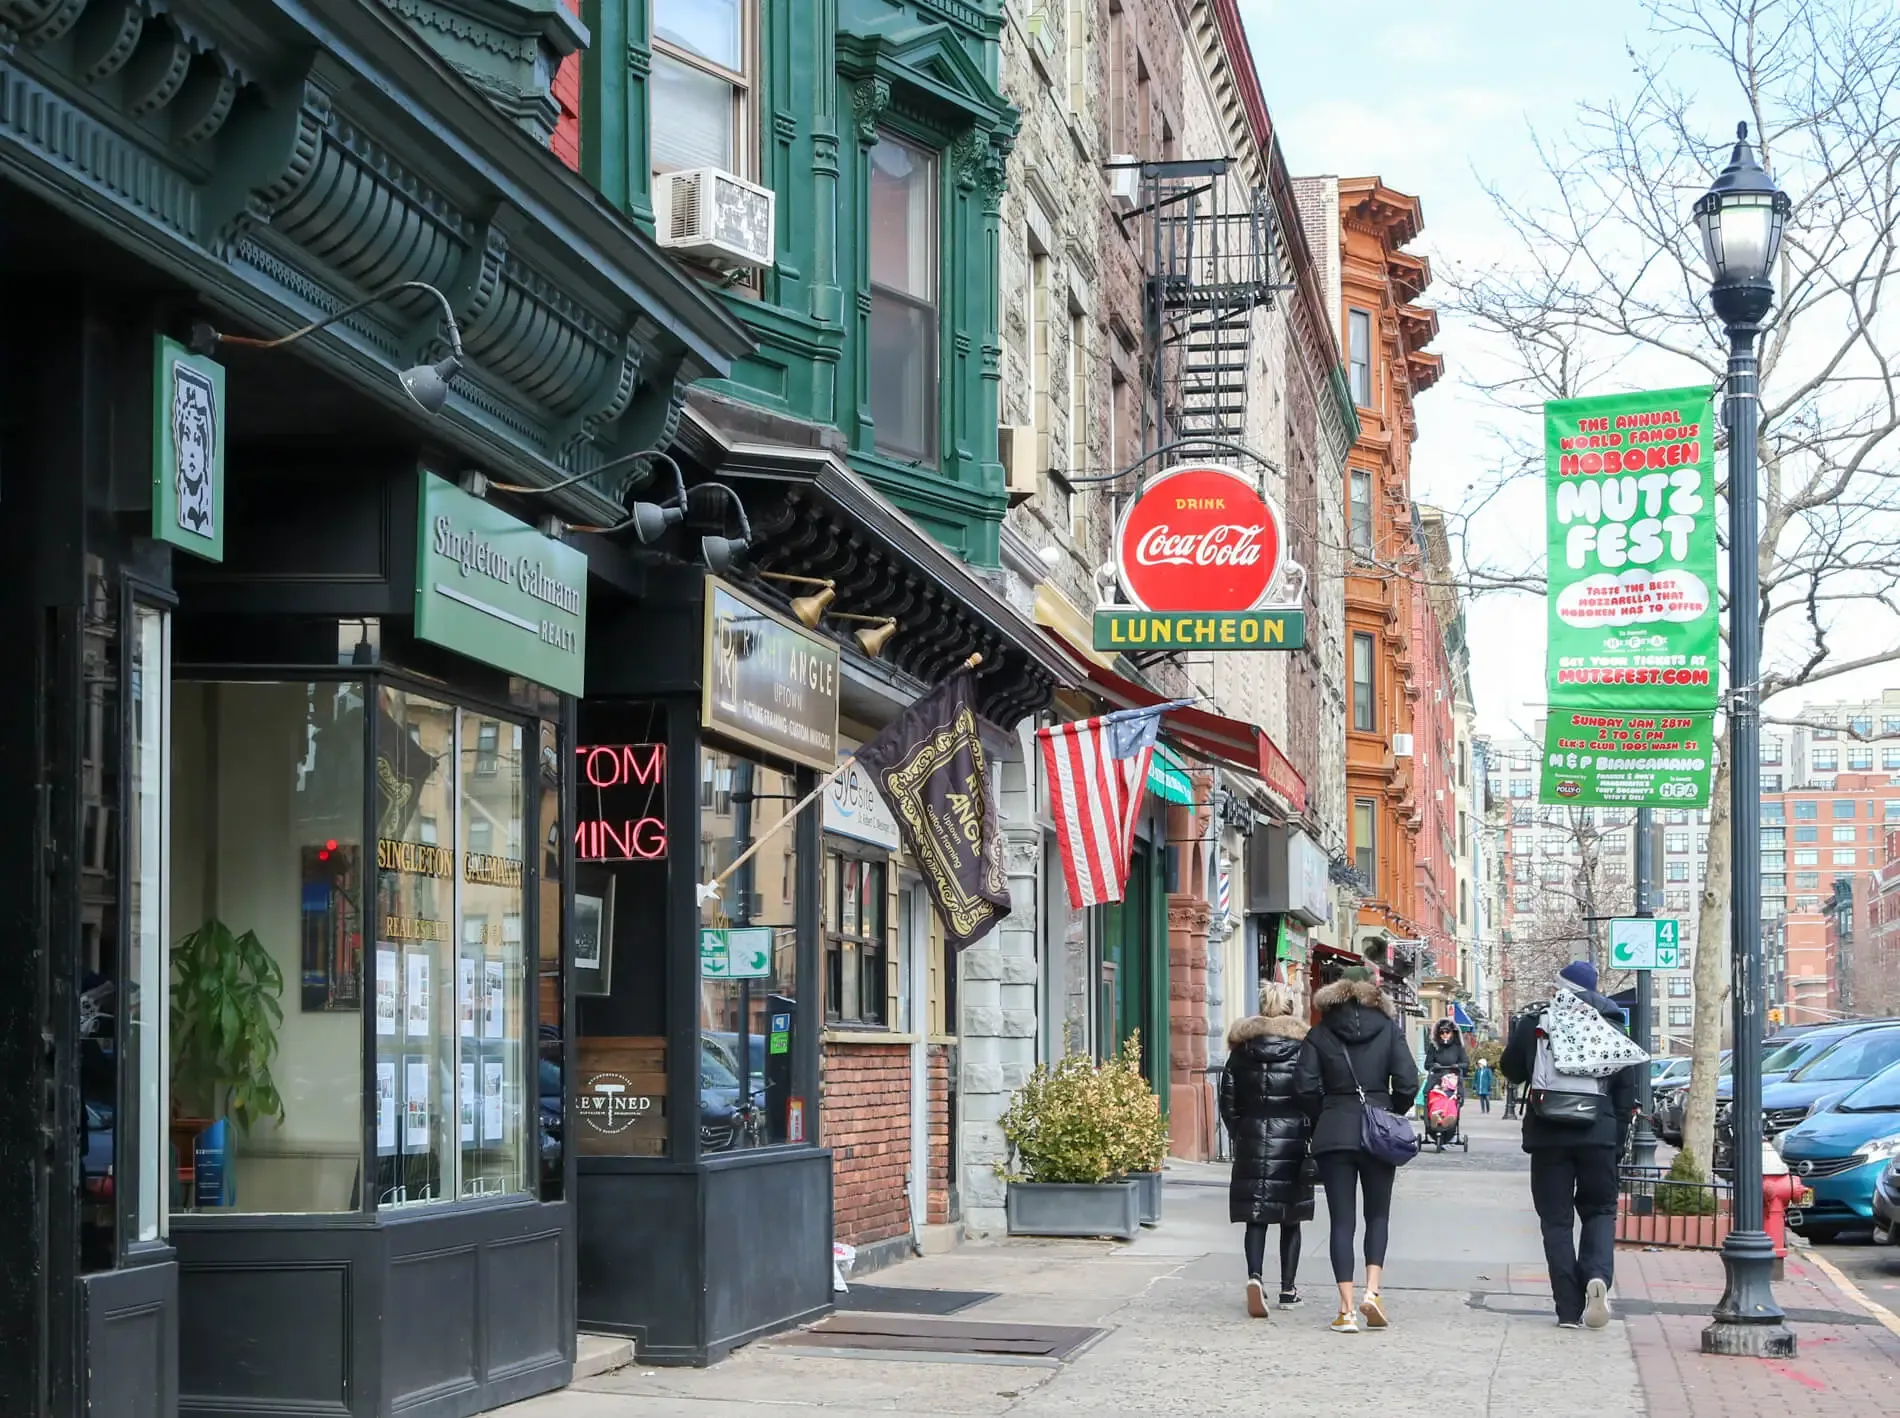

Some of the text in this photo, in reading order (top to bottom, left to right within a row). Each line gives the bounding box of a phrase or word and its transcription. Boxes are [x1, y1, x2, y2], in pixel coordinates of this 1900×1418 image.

[1578, 410, 1681, 433] THE ANNUAL
[1560, 424, 1699, 450] WORLD FAMOUS
[1559, 442, 1700, 476] HOBOKEN
[1176, 498, 1225, 510] DRINK
[1556, 468, 1704, 524] MUTZ
[1136, 524, 1265, 565] Coca-Cola
[1566, 514, 1695, 569] FEST
[518, 555, 580, 616] Galmann
[1586, 580, 1676, 596] TASTE THE BEST
[1560, 602, 1703, 617] HOBOKEN HAS TO OFFER
[1579, 591, 1684, 607] MOZZARELLA THAT
[1111, 618, 1285, 643] LUNCHEON
[789, 647, 833, 696] ANGLE
[1633, 654, 1686, 666] TICKETS
[1690, 655, 1706, 665] AT
[1558, 668, 1709, 685] MUTZFEST.COM
[1571, 714, 1623, 729] SUNDAY
[1661, 718, 1691, 729] 28TH
[1599, 729, 1664, 740] 2 TO 6 PM
[1549, 752, 1705, 771] M & P BIANCAMANO
[943, 813, 962, 845] Uptown
[940, 833, 962, 869] Framing
[377, 838, 524, 889] SINGLETON GALMANN
[386, 915, 412, 938] REAL
[1659, 922, 1675, 943] 4
